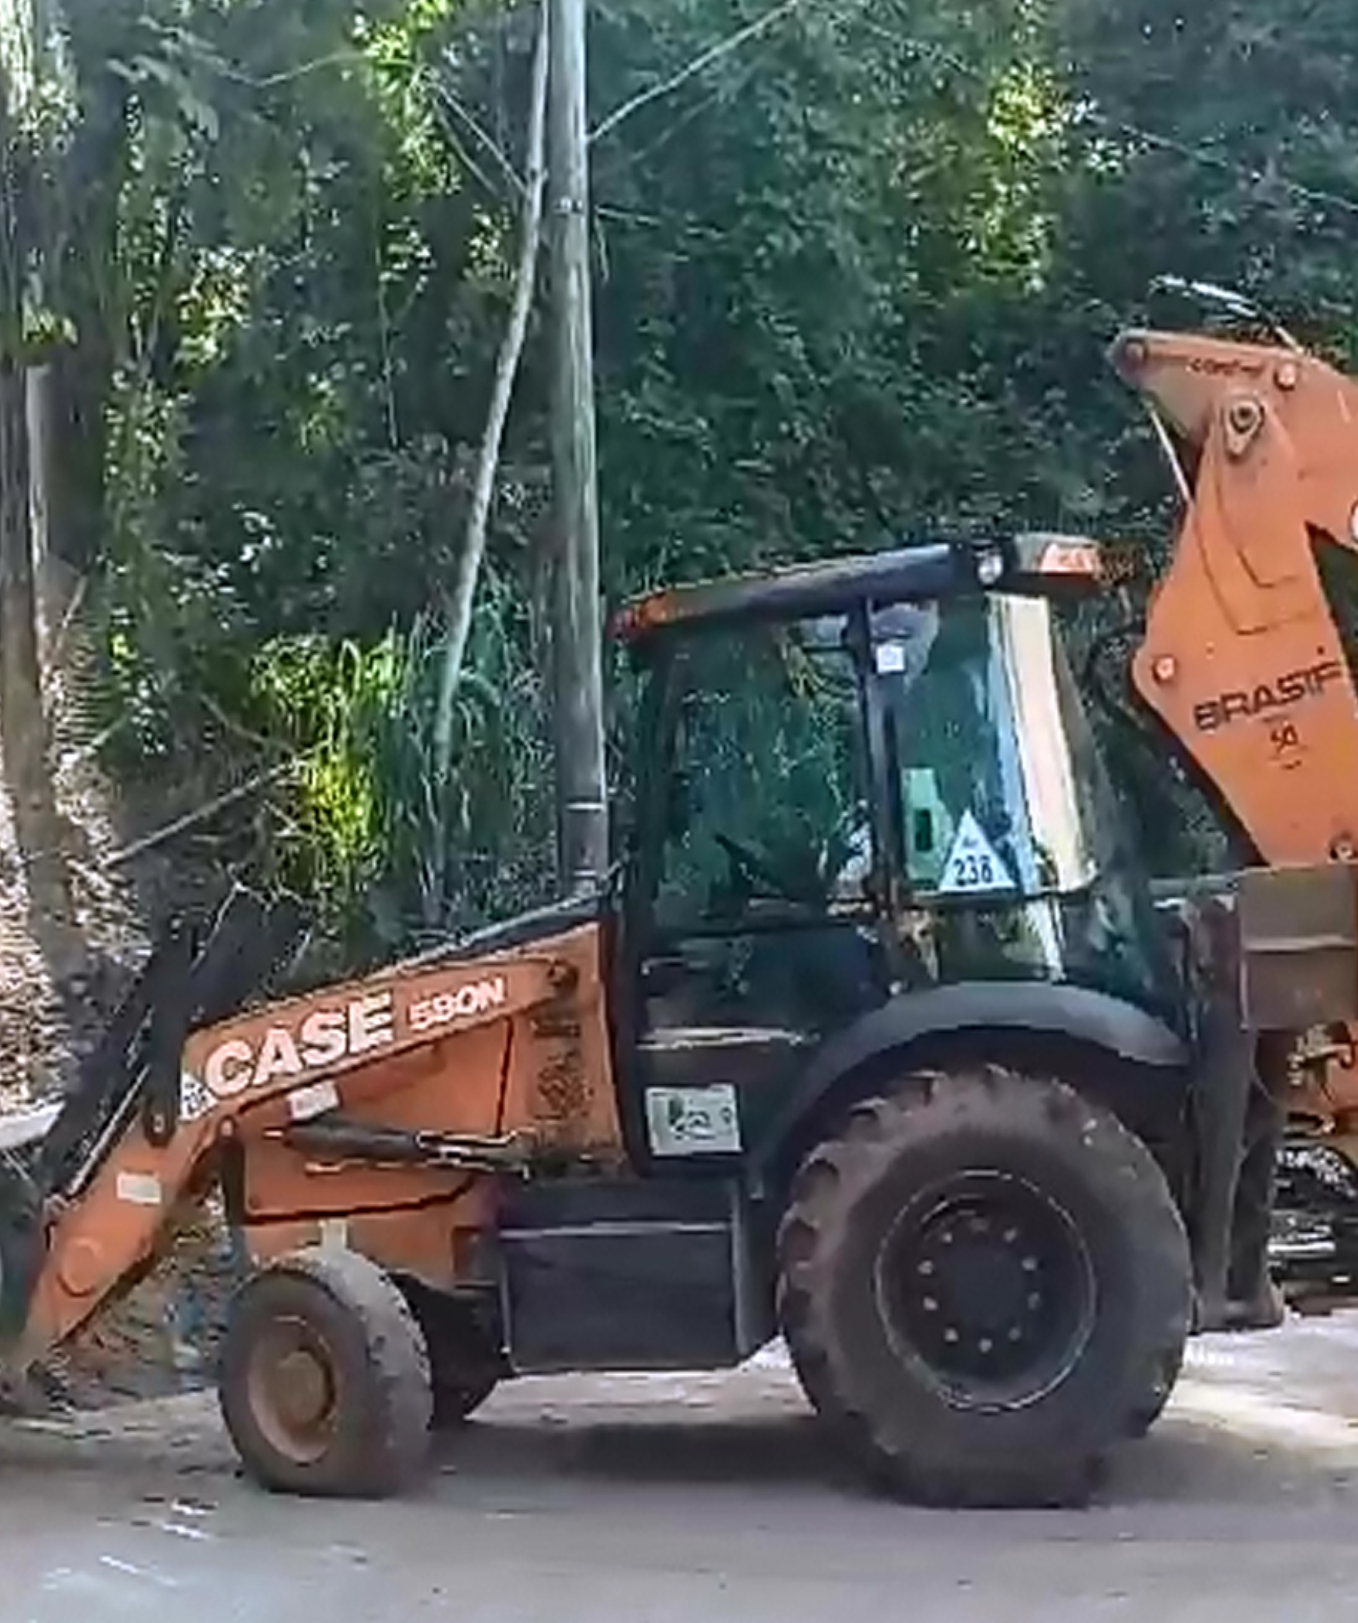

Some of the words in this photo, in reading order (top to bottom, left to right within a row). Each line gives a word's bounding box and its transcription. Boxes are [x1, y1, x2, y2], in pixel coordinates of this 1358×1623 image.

[1194, 660, 1342, 731] BRASIF
[953, 855, 994, 887] 238
[205, 994, 393, 1096] CASE
[409, 977, 505, 1031] 580N
